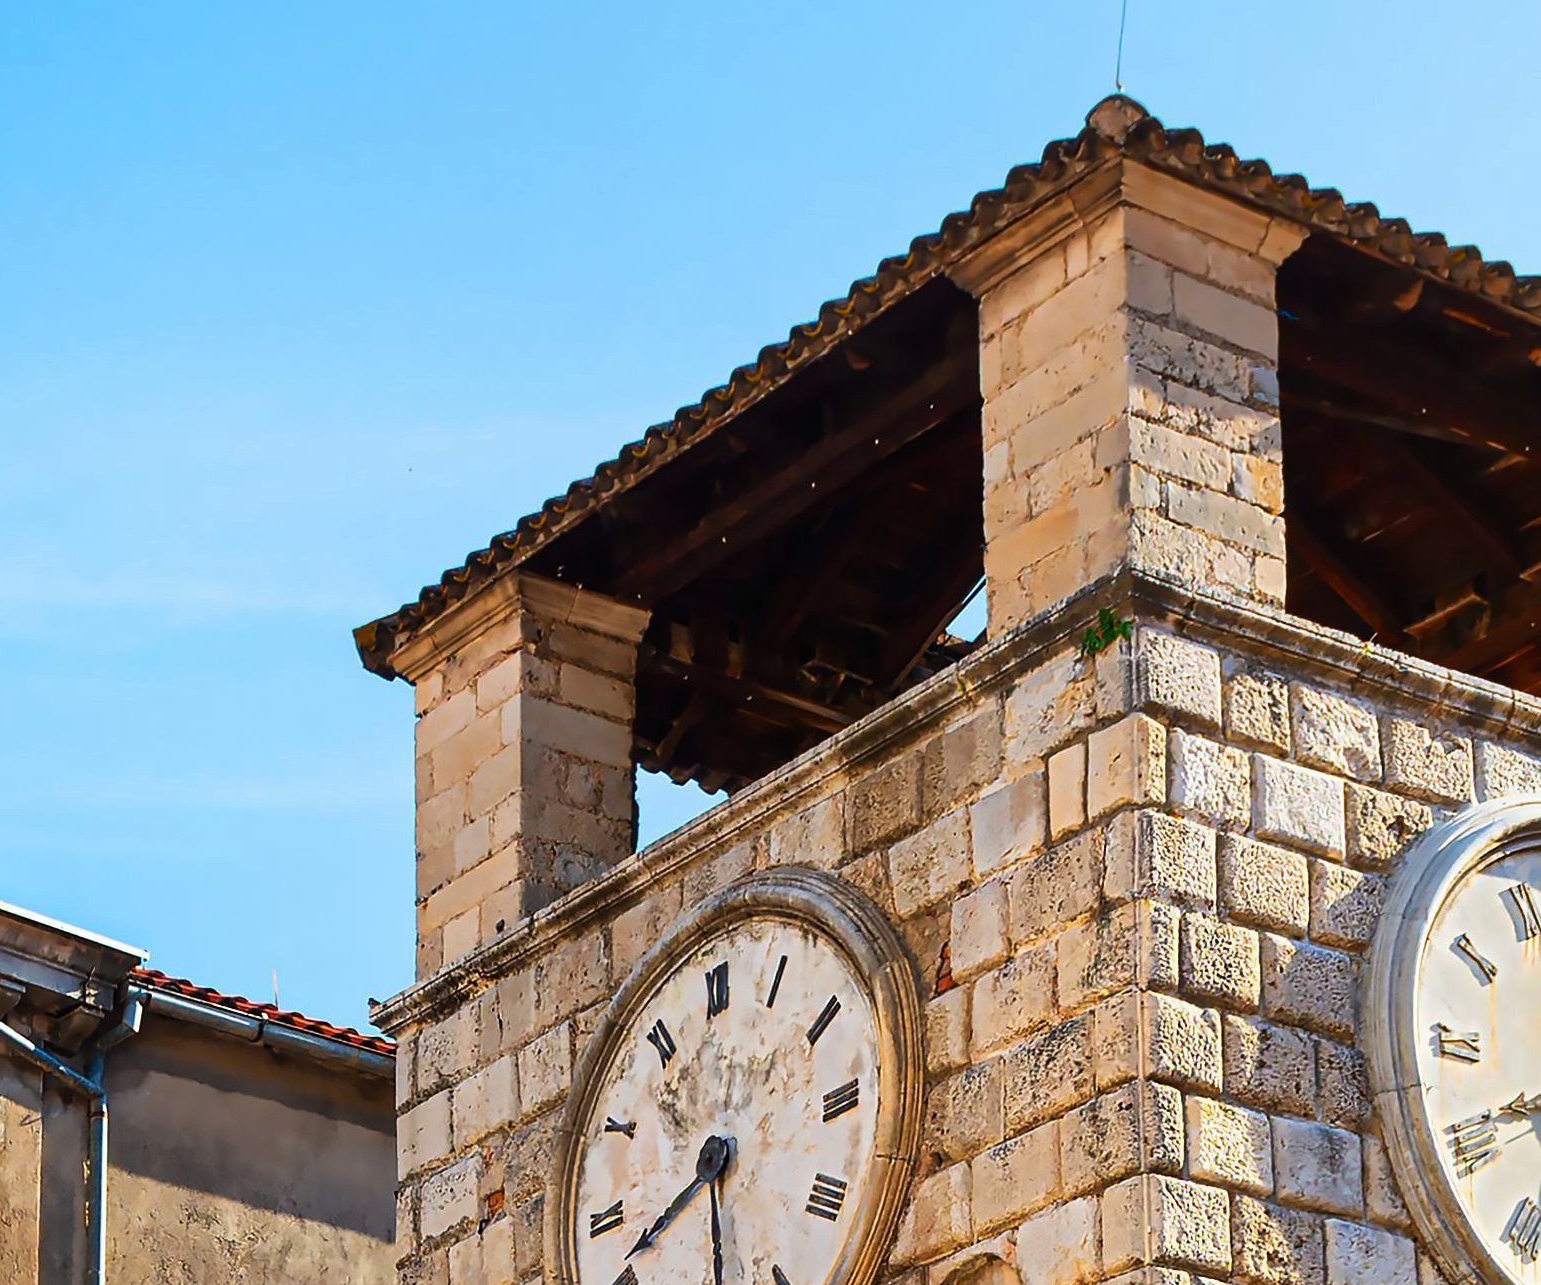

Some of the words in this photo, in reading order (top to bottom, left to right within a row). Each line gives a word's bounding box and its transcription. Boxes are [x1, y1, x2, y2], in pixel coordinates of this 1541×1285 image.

[766, 955, 788, 1008] I
[1457, 932, 1498, 984] X
[705, 961, 730, 1020] XII
[646, 1019, 677, 1069] XI
[806, 994, 841, 1046] II
[1437, 1022, 1480, 1066] IX
[822, 1077, 859, 1123] III
[604, 1117, 637, 1140] X
[1449, 1109, 1502, 1176] VIII
[590, 1200, 624, 1239] IX
[805, 1173, 847, 1222] IIII
